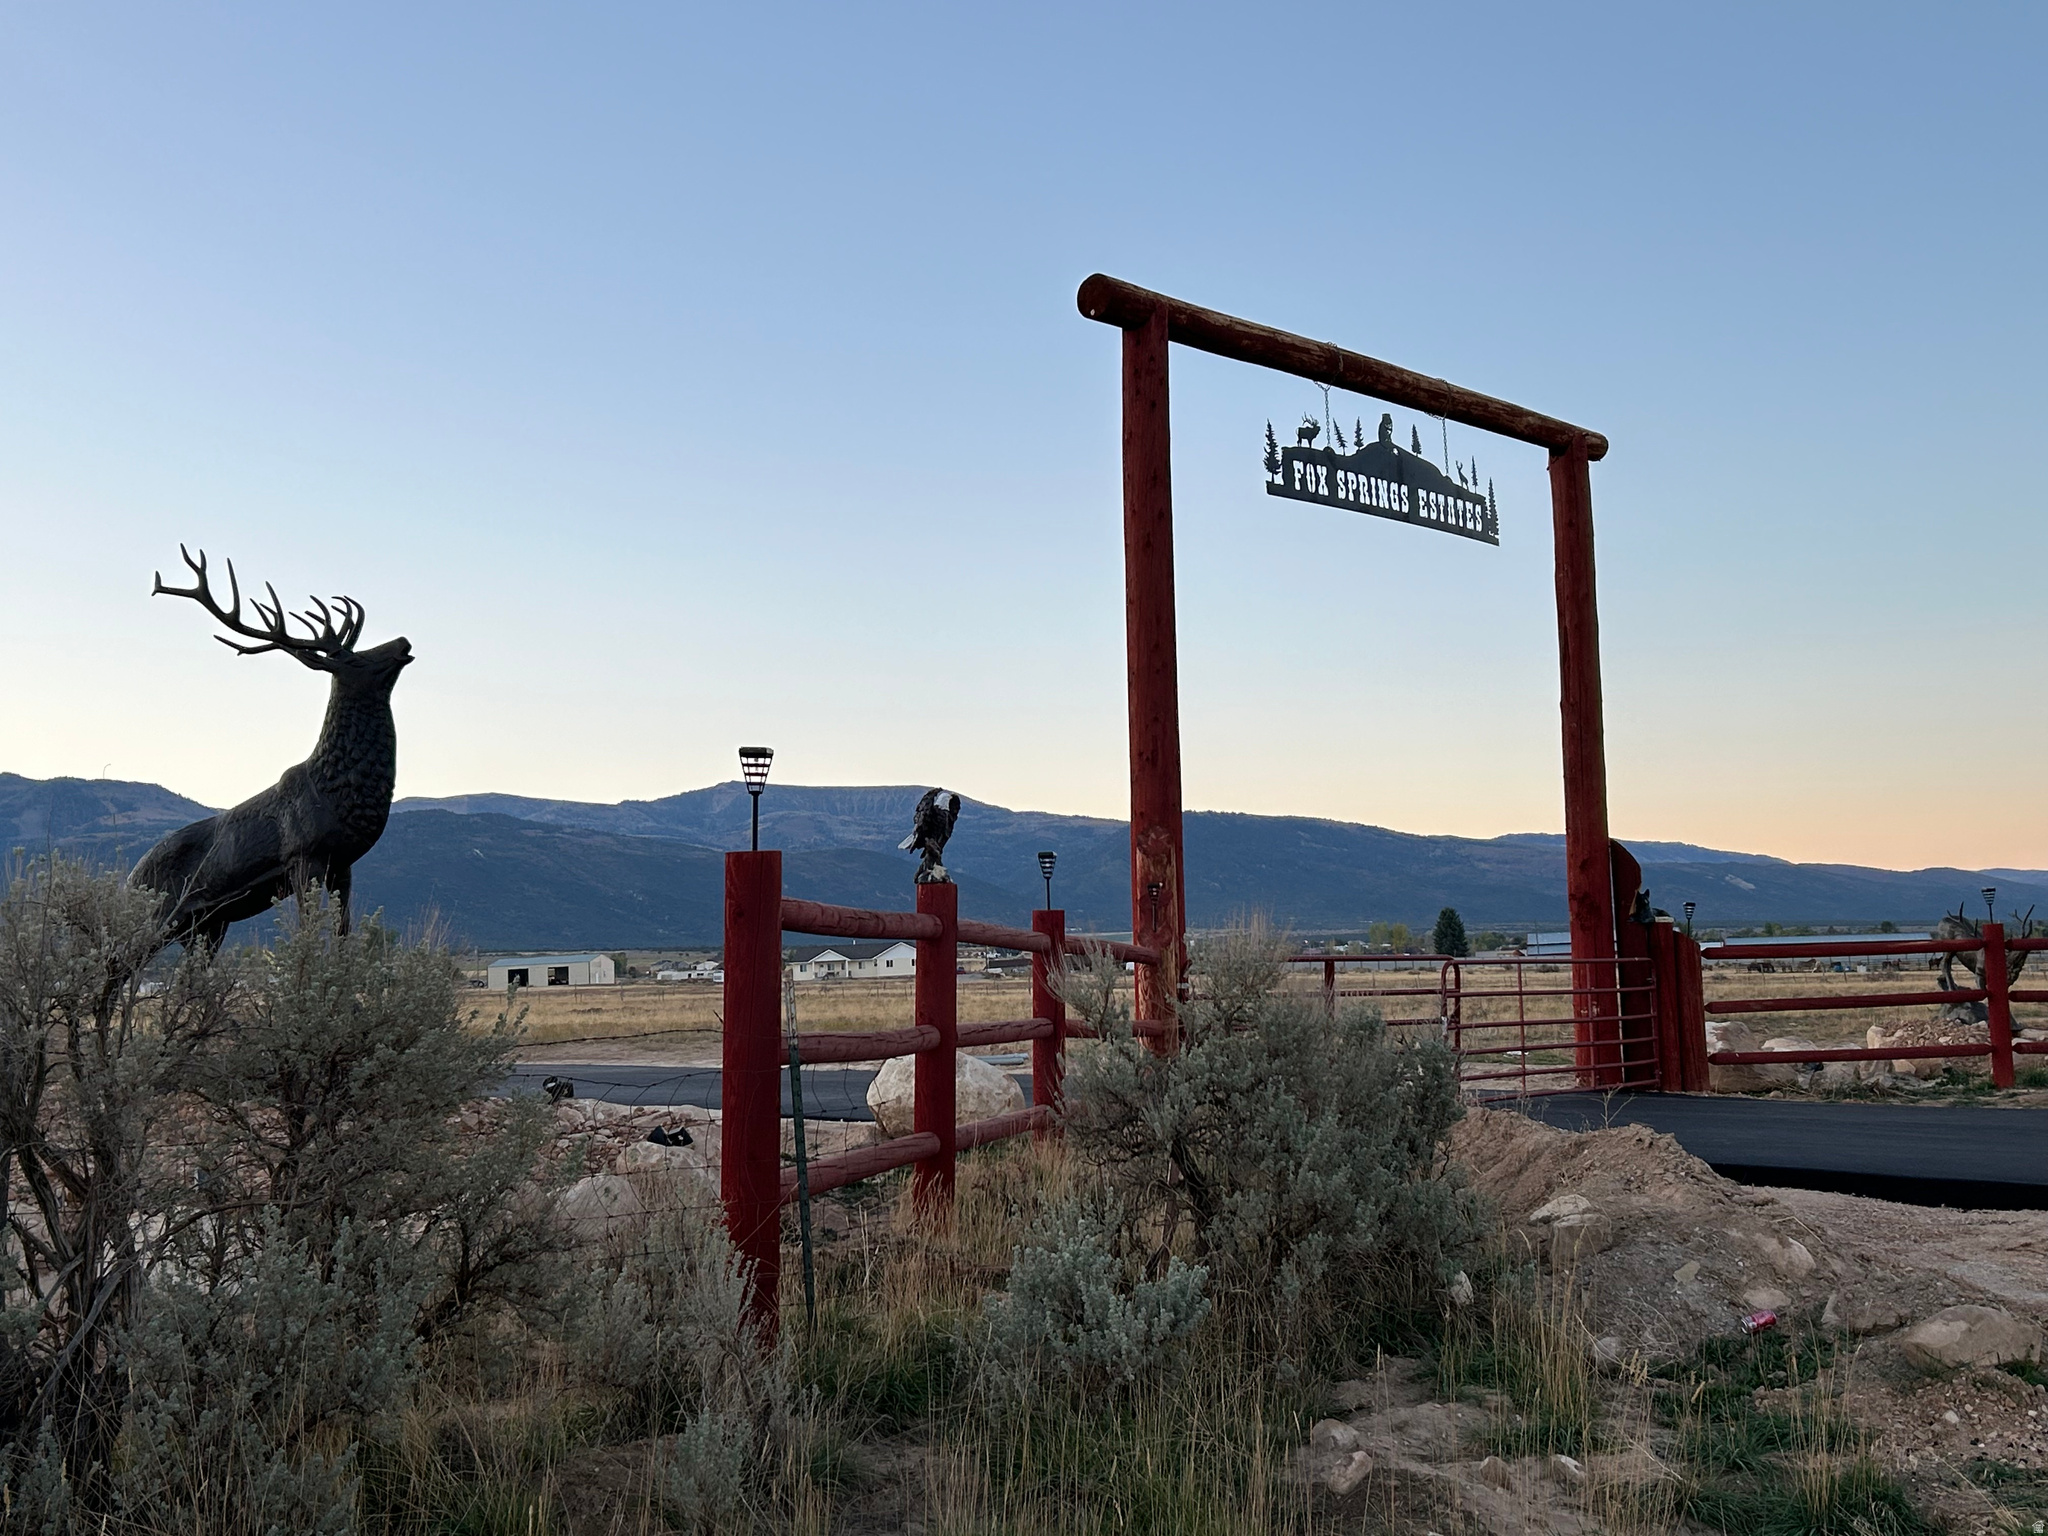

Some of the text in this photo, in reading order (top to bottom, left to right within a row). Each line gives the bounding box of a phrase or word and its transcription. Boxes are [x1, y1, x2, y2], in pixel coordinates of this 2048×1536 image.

[1292, 460, 1483, 532] FOX SPRINGS ESTATES
